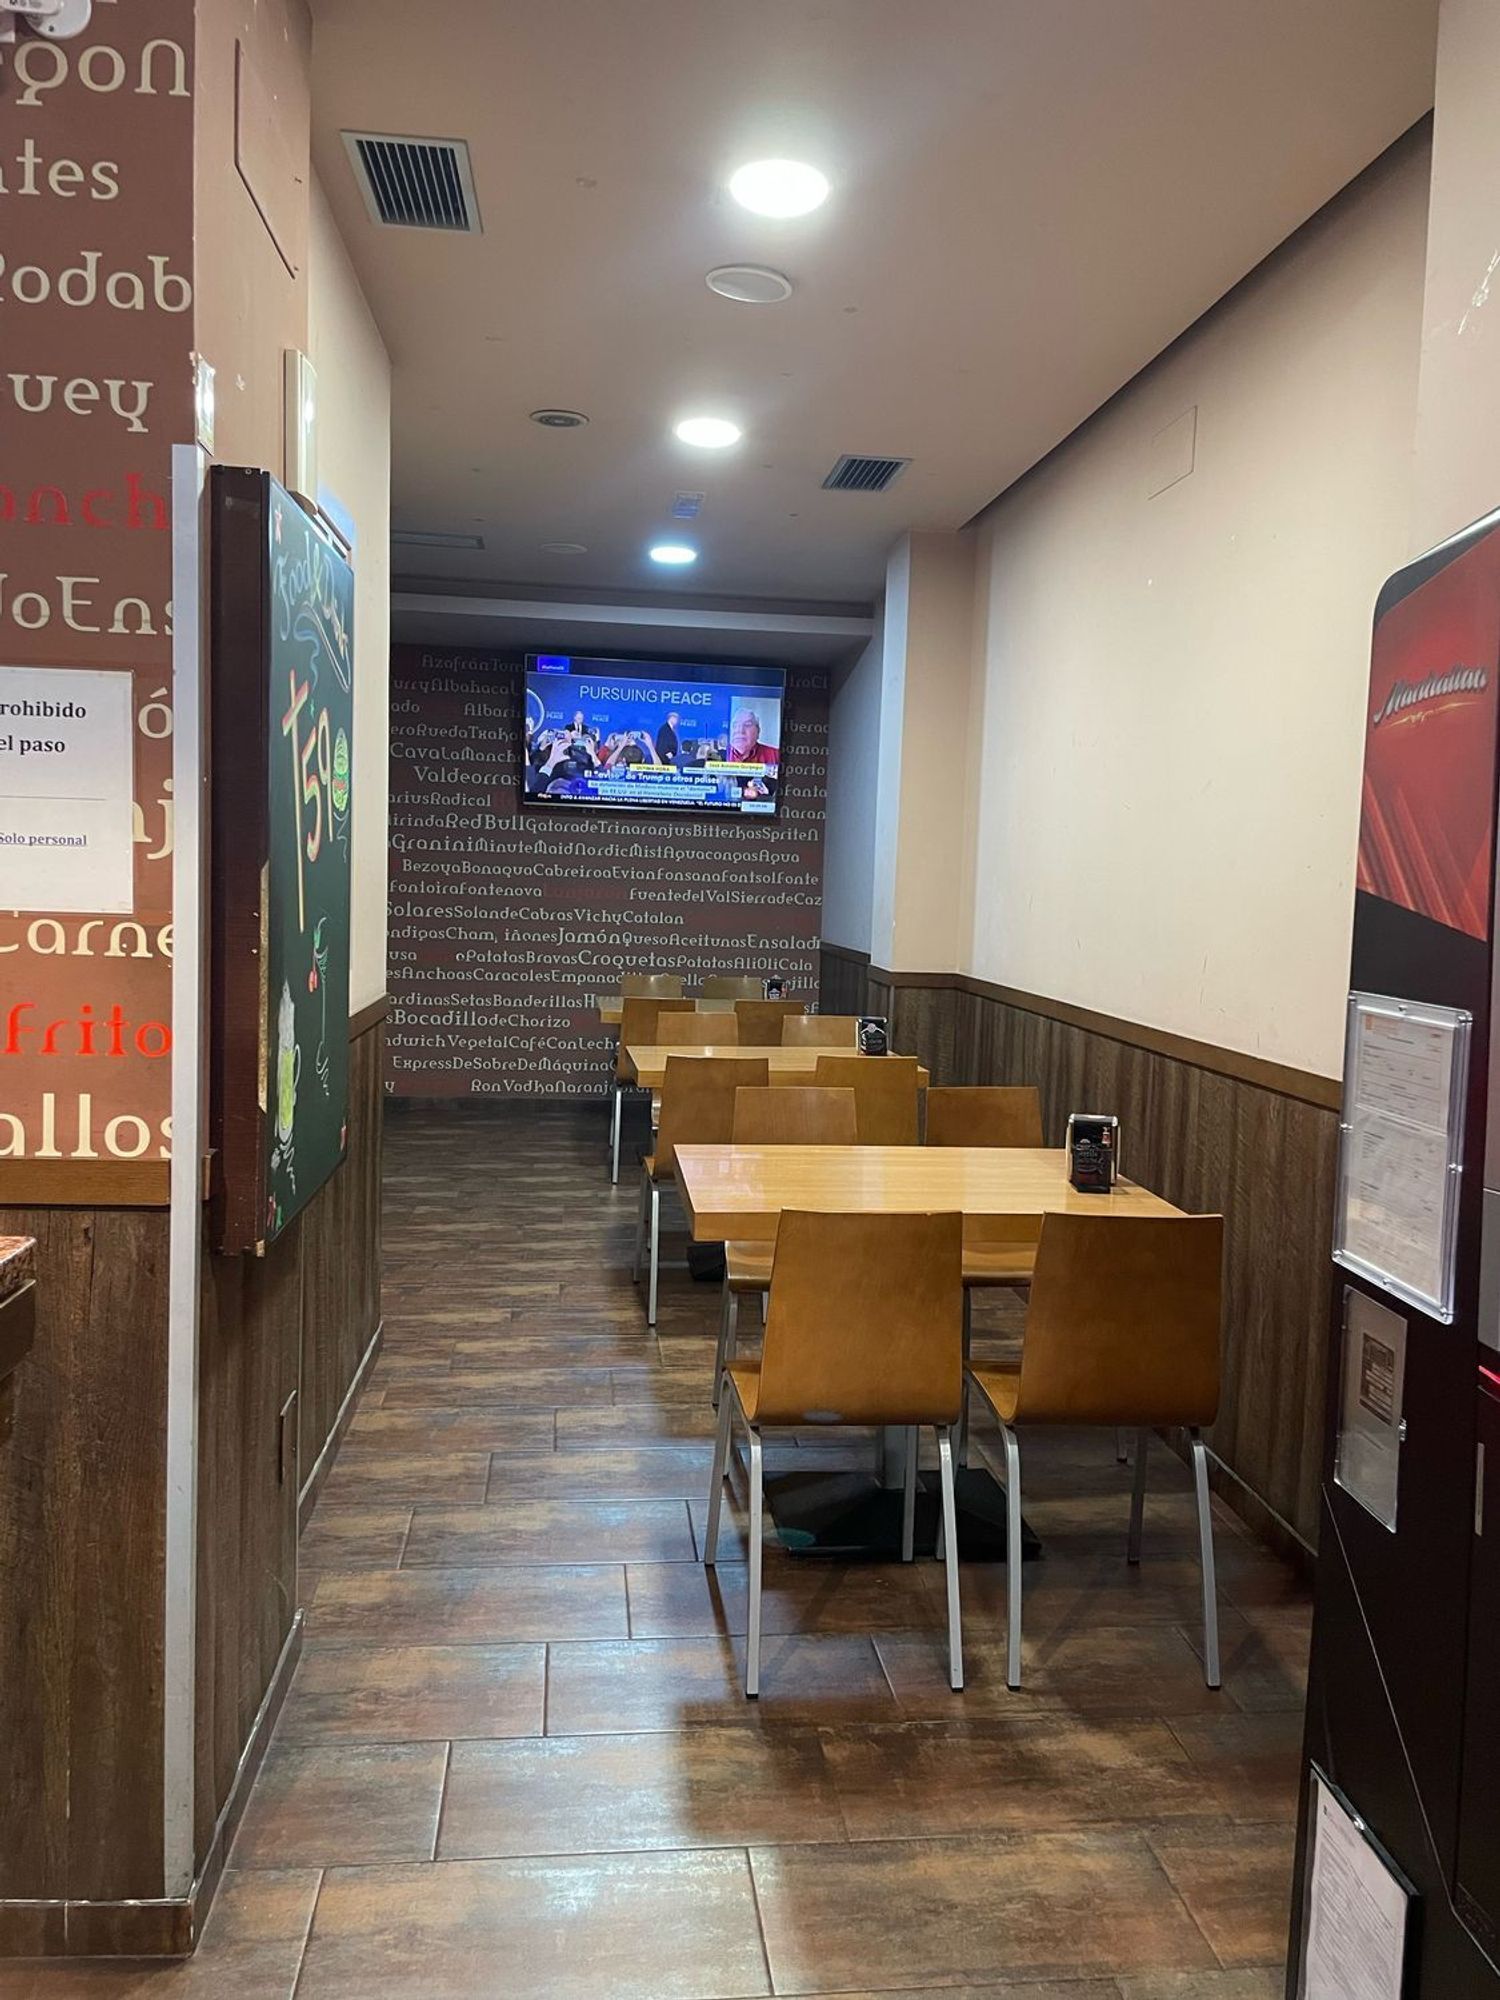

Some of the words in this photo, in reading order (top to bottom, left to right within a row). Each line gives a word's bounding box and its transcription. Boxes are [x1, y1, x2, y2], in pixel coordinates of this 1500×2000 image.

[0, 250, 193, 313] odab
[579, 685, 658, 704] PURSUING
[660, 691, 713, 706] PEACE
[20, 739, 66, 756] paso
[638, 772, 663, 783] Trump
[672, 775, 692, 783] otros
[28, 833, 88, 847] personal
